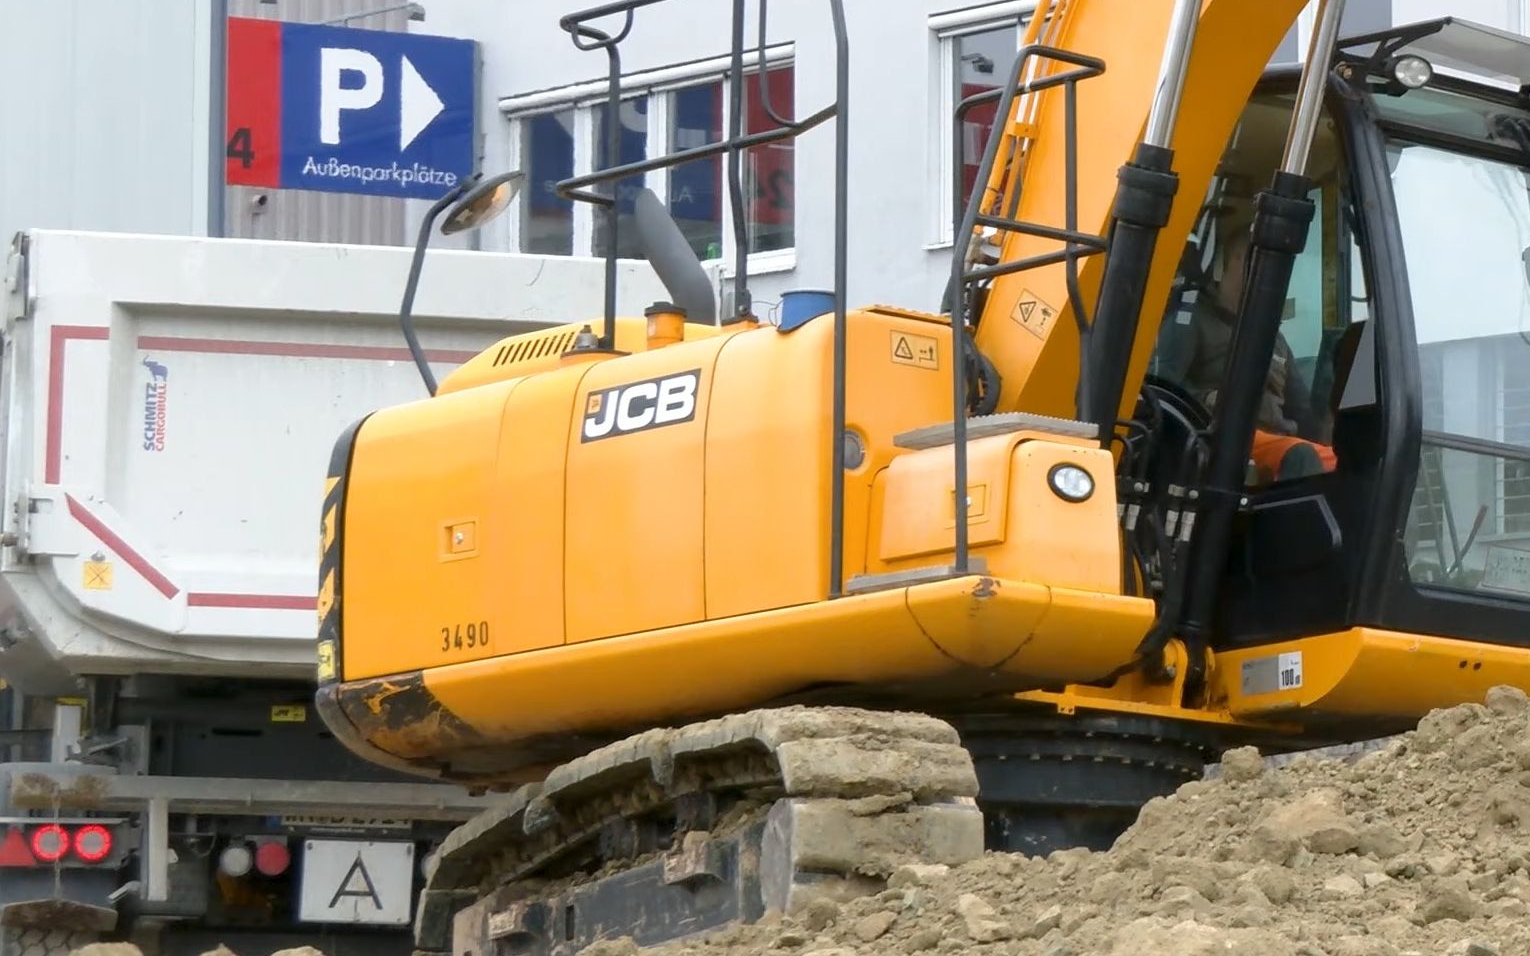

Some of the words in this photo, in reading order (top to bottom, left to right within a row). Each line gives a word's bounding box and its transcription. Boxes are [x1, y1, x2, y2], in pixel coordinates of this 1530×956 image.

[320, 47, 384, 144] P
[302, 156, 459, 187] Außenparkplätze
[144, 382, 157, 452] SCHMITZ
[156, 383, 168, 452] CARGOBULL
[584, 374, 697, 438] JCB
[441, 621, 489, 652] 3490
[328, 855, 383, 910] A
